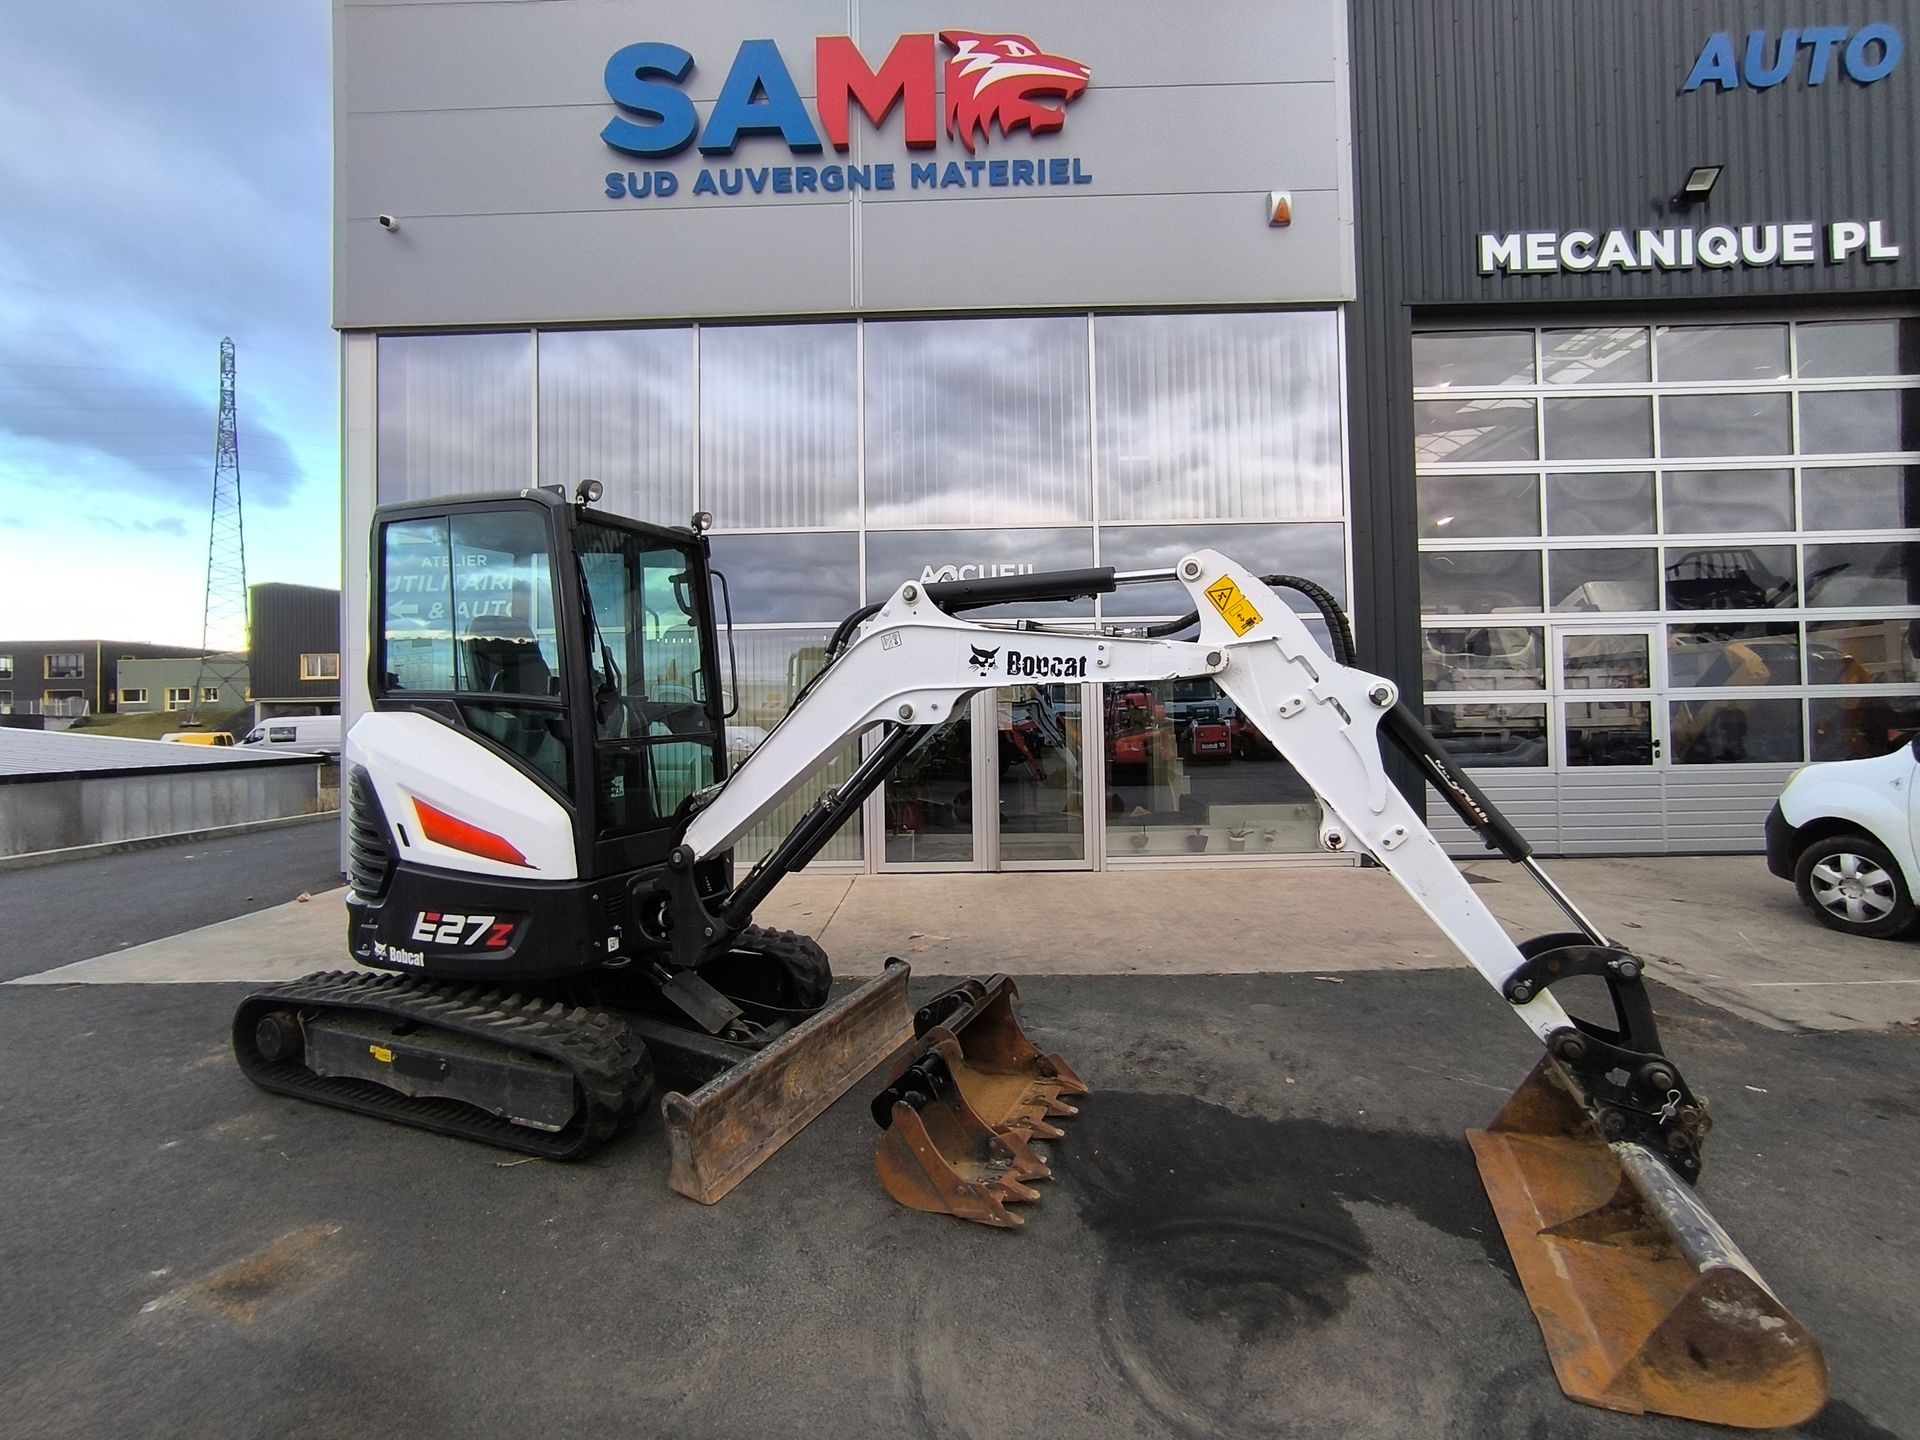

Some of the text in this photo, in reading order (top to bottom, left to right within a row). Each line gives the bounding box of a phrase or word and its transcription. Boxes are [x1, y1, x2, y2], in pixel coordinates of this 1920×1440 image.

[1682, 24, 1904, 92] AUTO
[600, 32, 937, 157] SAM
[605, 157, 1093, 198] SUD AUVERGNE MATERIEL
[1478, 219, 1901, 274] MECANIQUE PL
[421, 555, 487, 568] ATELIER
[428, 602, 444, 619] &
[1006, 650, 1088, 678] Bobcat
[388, 946, 425, 967] Bobcat
